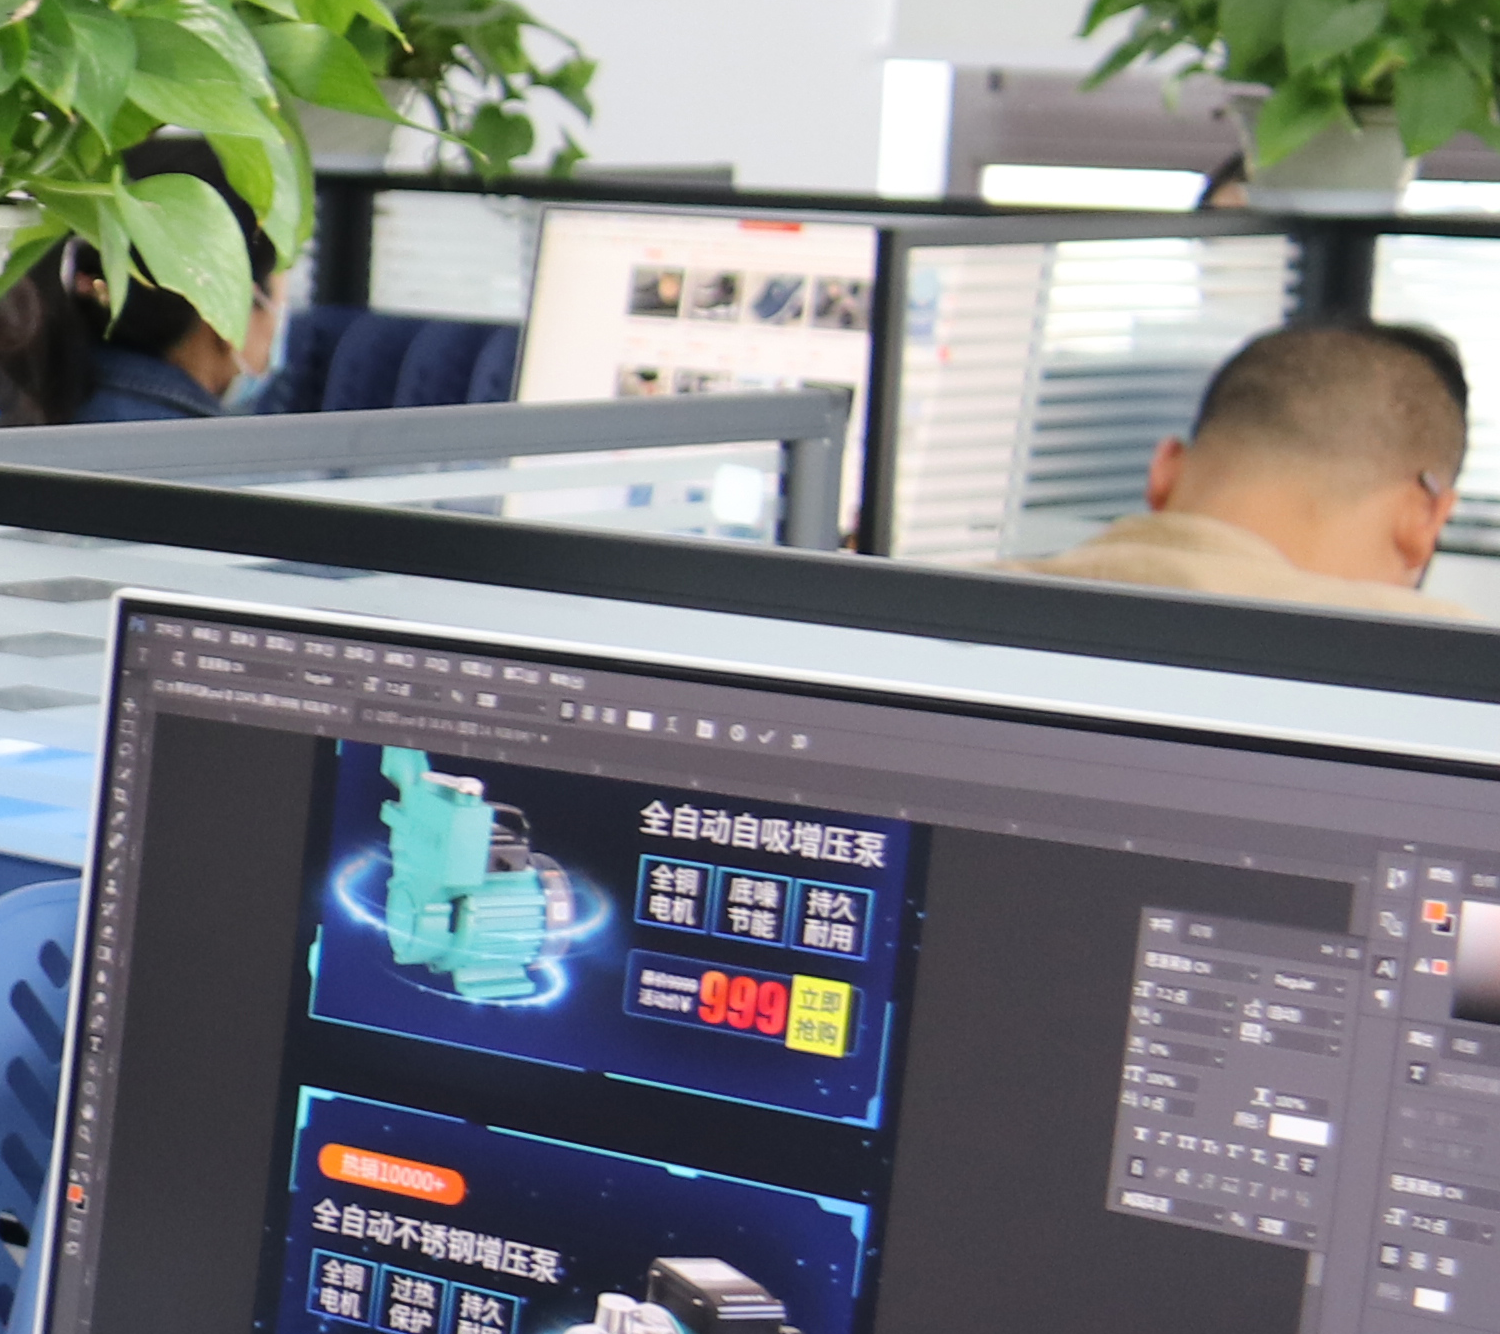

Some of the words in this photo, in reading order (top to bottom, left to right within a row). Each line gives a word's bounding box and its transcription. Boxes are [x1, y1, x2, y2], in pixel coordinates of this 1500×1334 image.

[639, 800, 887, 868] 全自动自吸增压泵
[650, 864, 700, 897] 全铜
[649, 893, 696, 926] 电机
[727, 906, 776, 939] 节能
[807, 887, 857, 923] 持久
[803, 917, 854, 952] 耐用
[698, 970, 788, 1035] 999
[800, 987, 843, 1014] 立即
[794, 1019, 840, 1046] 抢购
[312, 1198, 560, 1284] 全自动不锈钢增压泵
[319, 1287, 361, 1319] 电机
[390, 1274, 435, 1309] 过热
[460, 1291, 505, 1327] 持久
